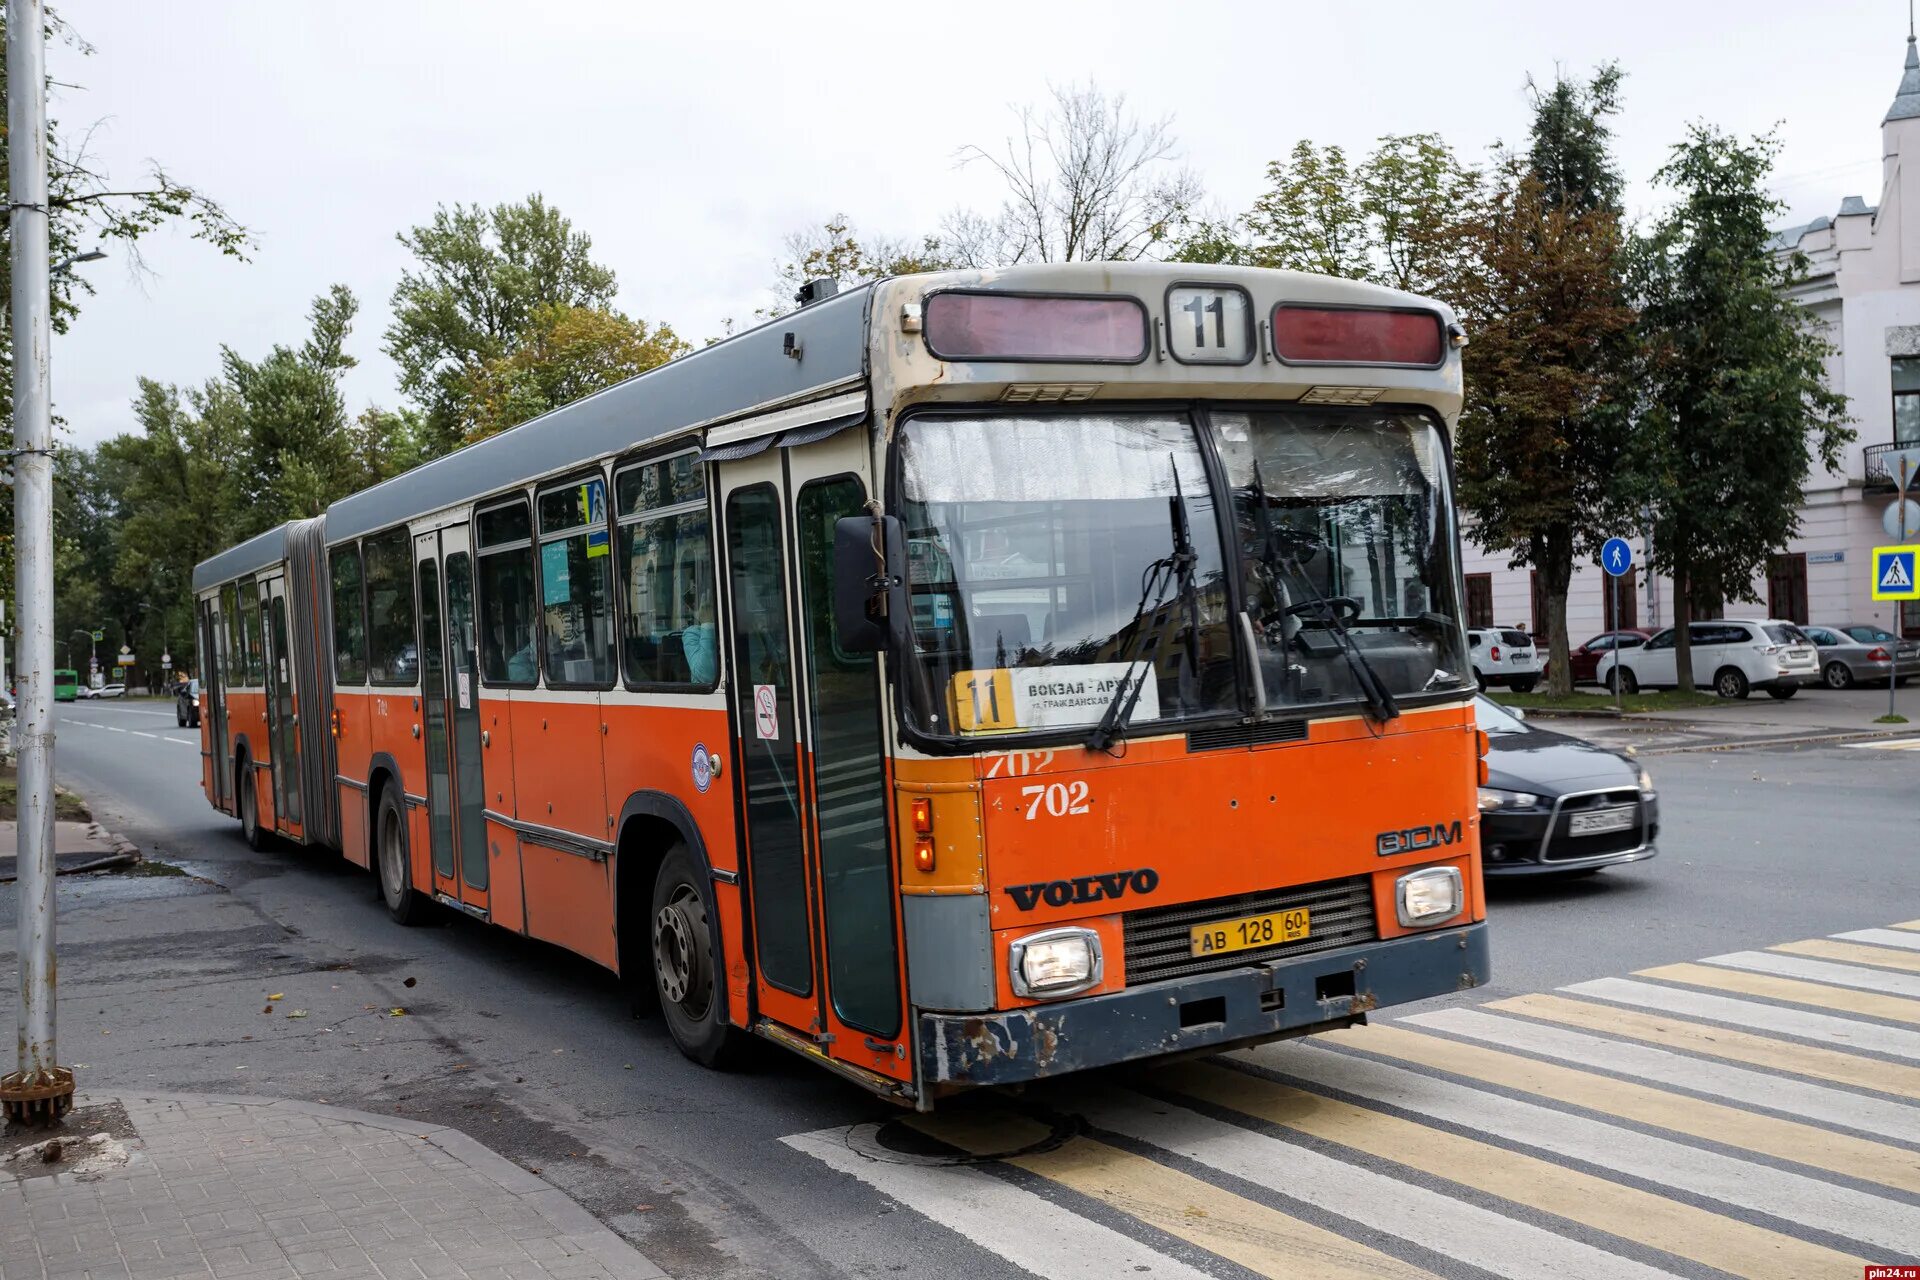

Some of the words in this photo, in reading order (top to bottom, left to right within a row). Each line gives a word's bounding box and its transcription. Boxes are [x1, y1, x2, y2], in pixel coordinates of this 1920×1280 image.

[1183, 295, 1225, 348] 11
[967, 676, 1000, 724] 11
[1028, 682, 1085, 697] ВОКЗАЛ
[1043, 696, 1109, 709] ГРАЖДАНСКАЯ
[1022, 781, 1090, 820] 702
[1376, 820, 1462, 857] B10M
[1005, 868, 1159, 912] VOLVO
[1237, 918, 1274, 945] 128
[1285, 912, 1303, 931] 60
